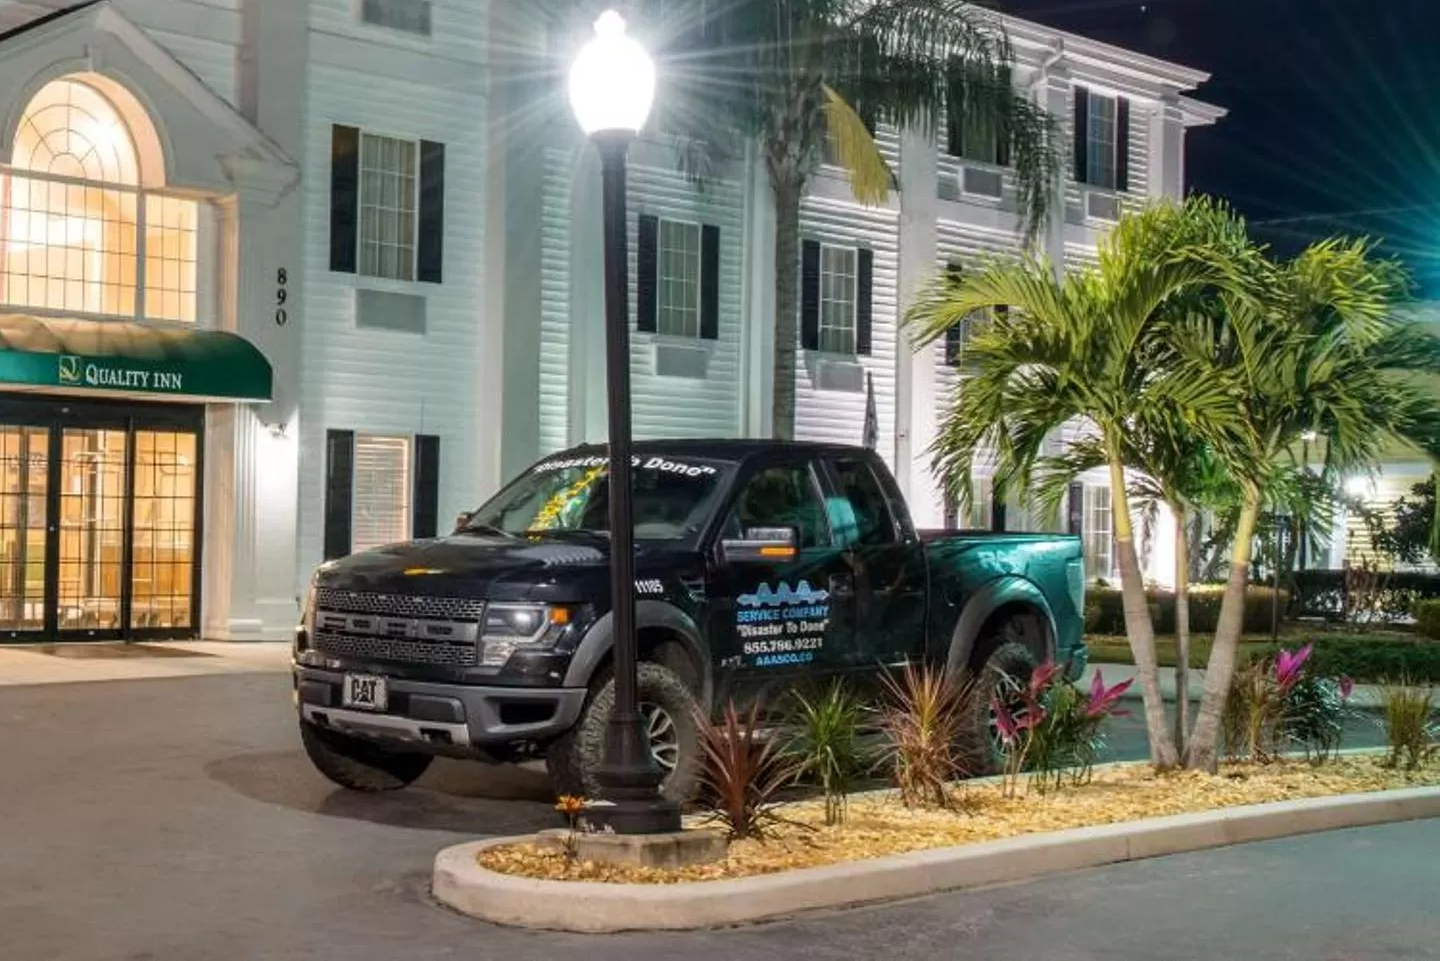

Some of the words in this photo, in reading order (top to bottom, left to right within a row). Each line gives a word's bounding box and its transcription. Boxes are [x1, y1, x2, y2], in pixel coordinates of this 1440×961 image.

[275, 267, 288, 328] 890
[85, 363, 150, 387] QUALITY
[153, 372, 182, 389] INN
[736, 608, 780, 622] SERVICE
[782, 605, 830, 619] COMPANY
[786, 621, 798, 634] To
[351, 679, 377, 703] CAT
